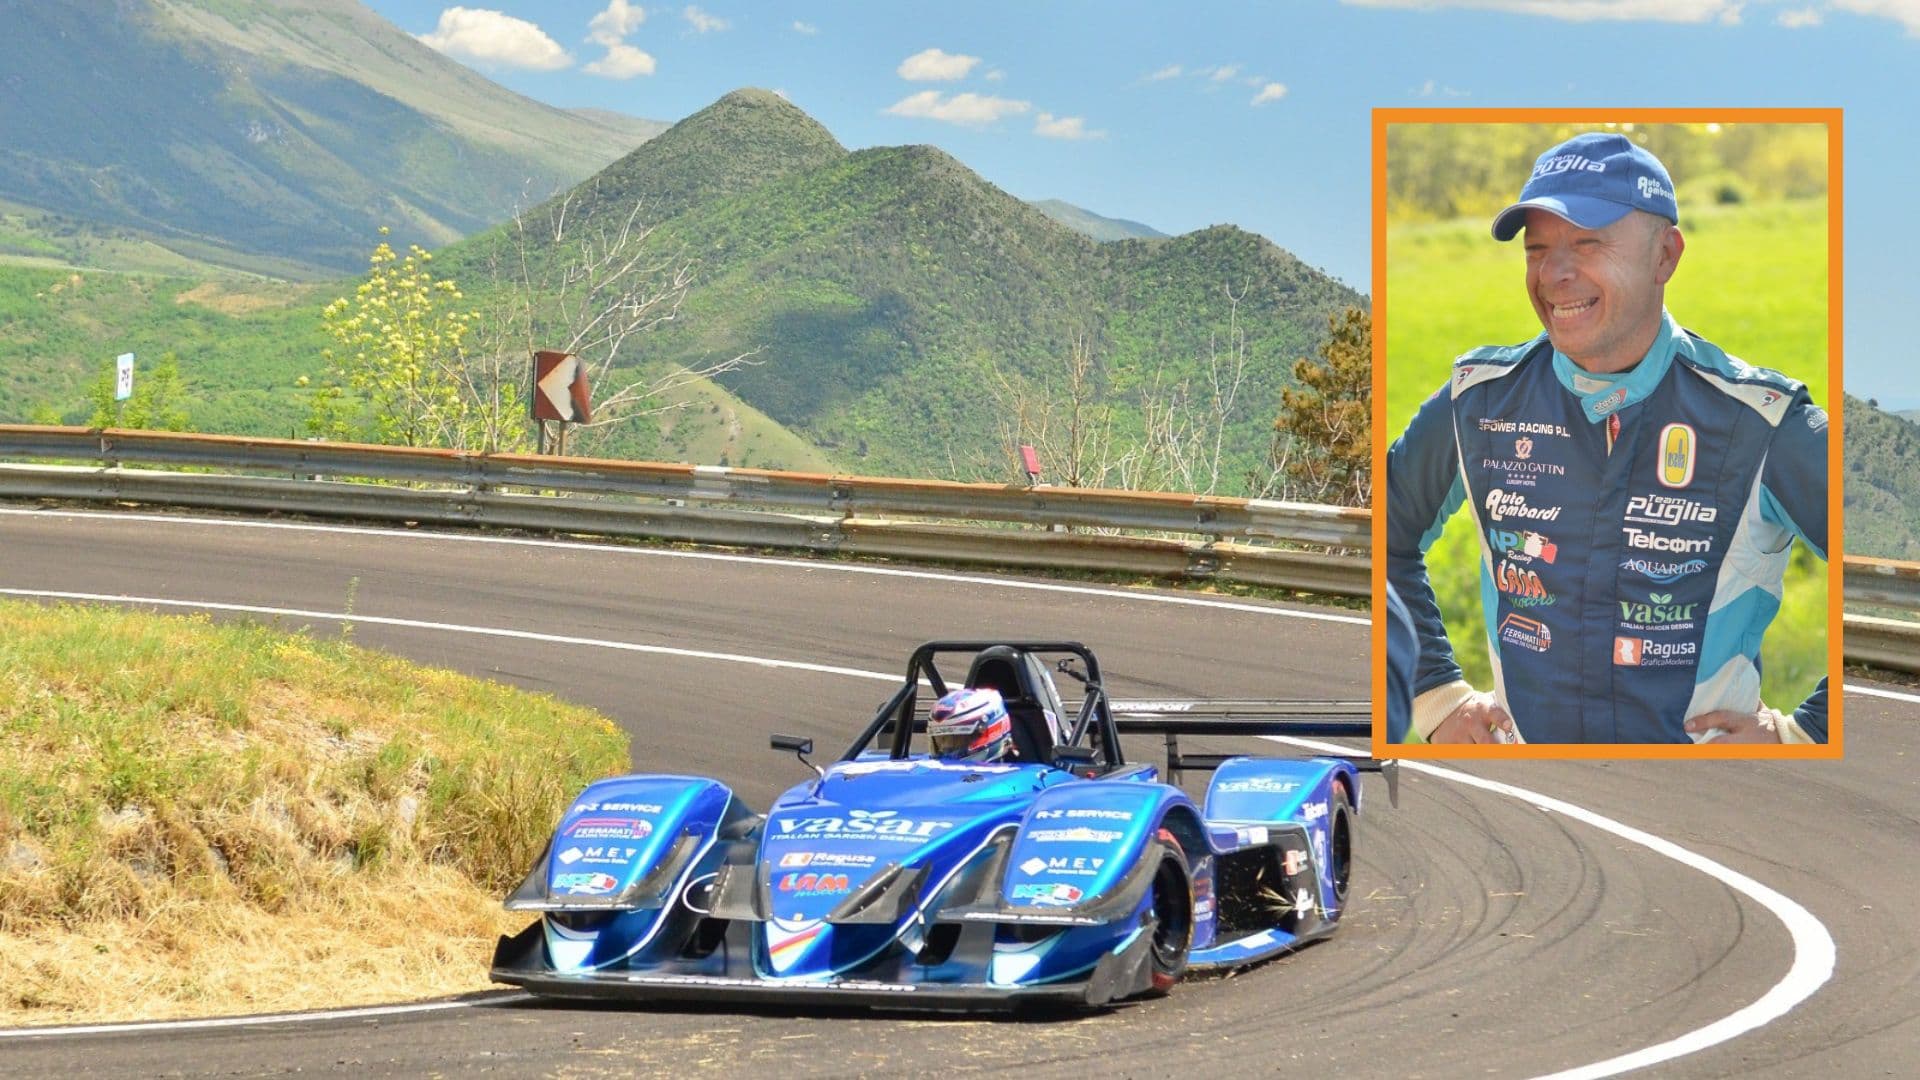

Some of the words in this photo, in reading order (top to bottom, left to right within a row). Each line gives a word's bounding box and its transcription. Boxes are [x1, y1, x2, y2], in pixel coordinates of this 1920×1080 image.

[1638, 176, 1660, 190] Auto
[1518, 422, 1554, 435] RACING
[1555, 426, 1571, 437] P.L.
[1483, 459, 1527, 471] PALAZZO
[1528, 462, 1565, 475] GATTINI
[1486, 488, 1525, 510] Auto
[1648, 494, 1687, 505] Team
[1491, 501, 1562, 522] Lombardi
[1624, 496, 1718, 526] Puglia
[1489, 528, 1518, 553] NP
[1622, 527, 1711, 553] Telcom
[1507, 550, 1533, 564] Racing
[1623, 558, 1703, 574] AQUARIUS
[1497, 559, 1548, 598] LAM
[1619, 600, 1698, 624] vasar
[1621, 622, 1645, 630] ITALIAN
[1503, 627, 1539, 647] FERRAMATI
[1642, 640, 1696, 659] Ragusa
[601, 803, 663, 813] SERVICE
[1036, 811, 1064, 820] R-Z
[1065, 810, 1133, 820] SERVICE
[777, 817, 953, 836] vasar
[770, 833, 820, 841] ITALIAN
[878, 834, 930, 843] DESIGN
[812, 852, 877, 866] Ragusa
[778, 872, 849, 891] LAM
